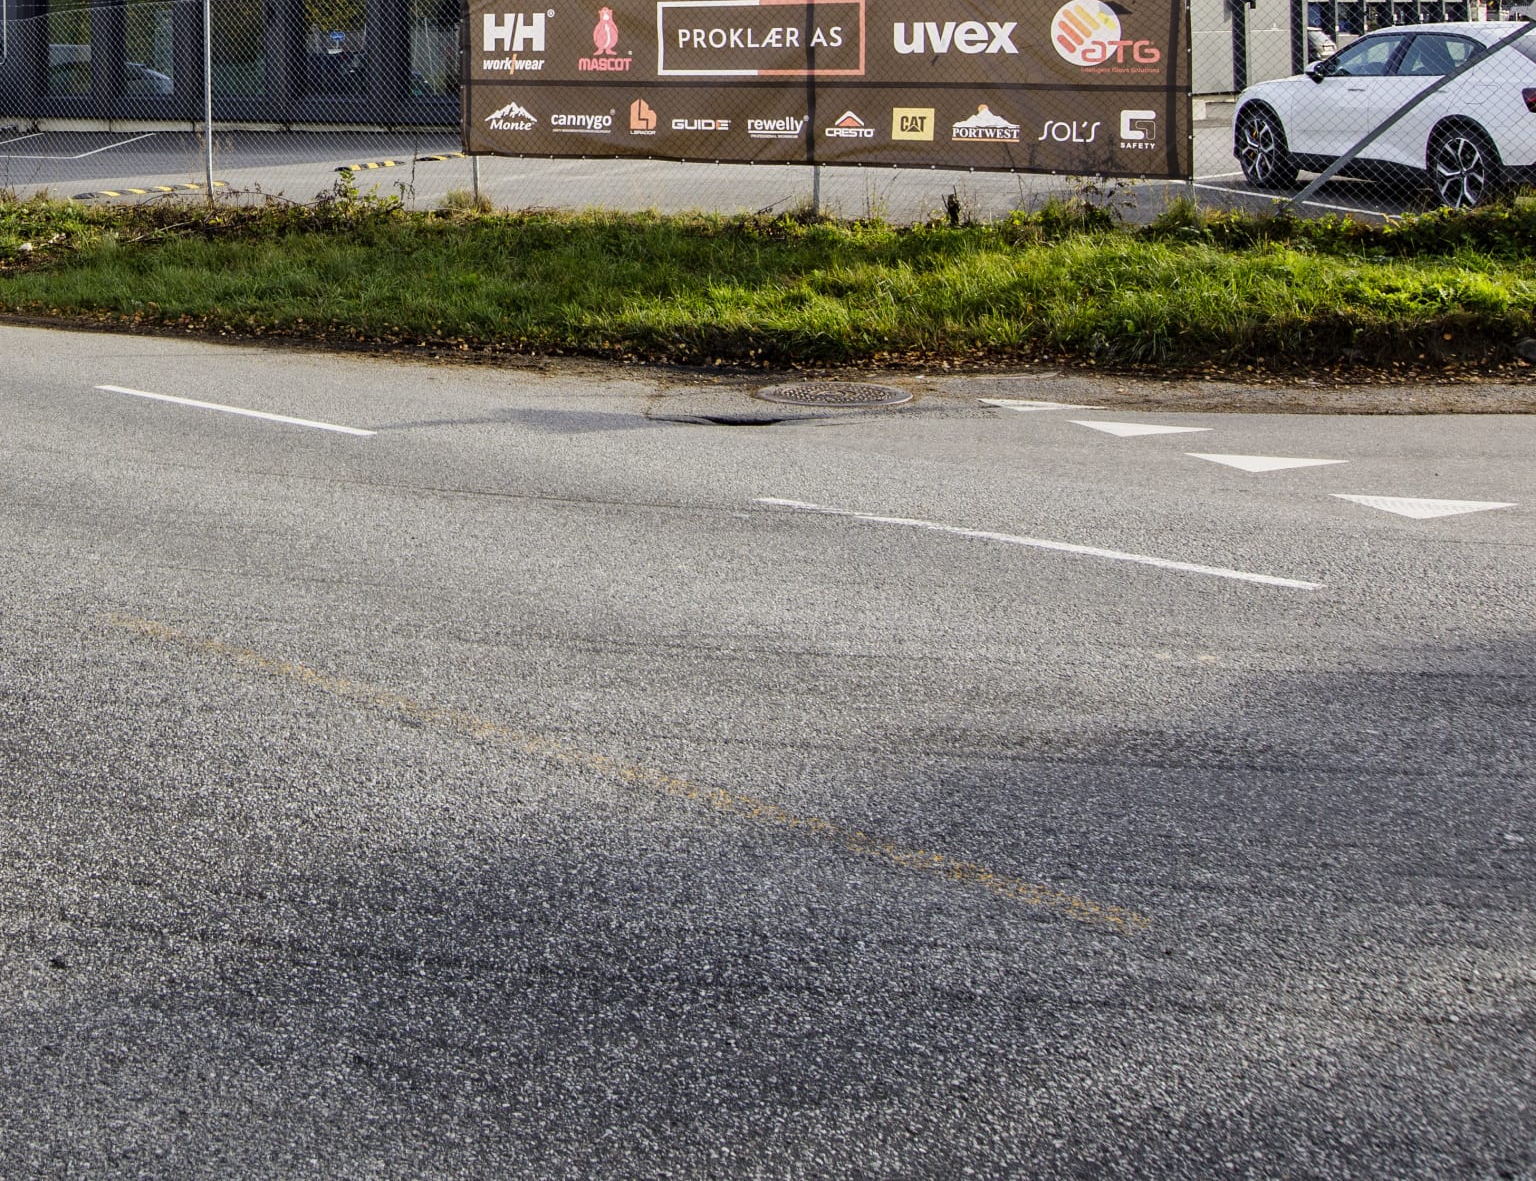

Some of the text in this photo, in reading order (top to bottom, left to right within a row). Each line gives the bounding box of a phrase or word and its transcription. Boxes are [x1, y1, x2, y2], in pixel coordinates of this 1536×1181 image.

[678, 26, 843, 48] PROKLÆR AS
[893, 21, 1019, 54] uvex
[578, 57, 632, 71] MASCOT
[490, 119, 532, 130] Monte
[550, 114, 612, 130] cannygo
[671, 119, 729, 131] GUIDE
[747, 116, 804, 133] rewelly
[900, 115, 927, 132] CAT
[825, 127, 874, 138] CRESTO
[951, 127, 1020, 139] PORTWEST
[1120, 142, 1156, 150] SAFETY
